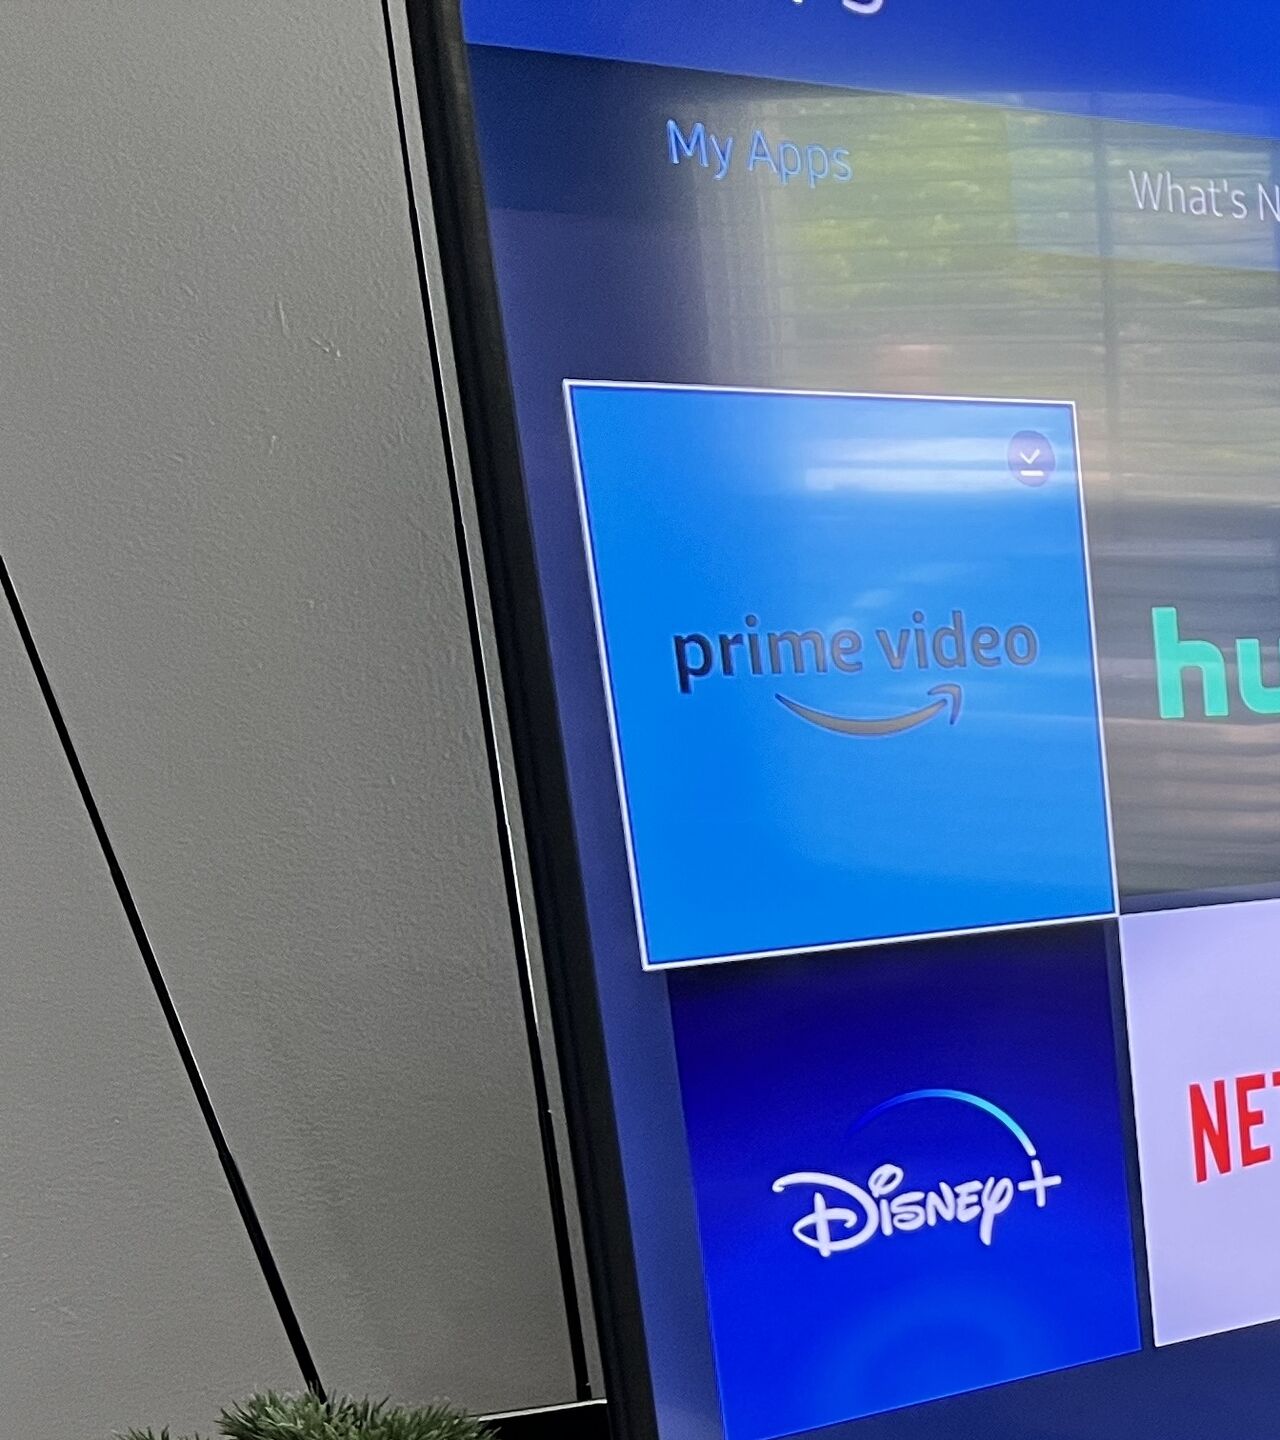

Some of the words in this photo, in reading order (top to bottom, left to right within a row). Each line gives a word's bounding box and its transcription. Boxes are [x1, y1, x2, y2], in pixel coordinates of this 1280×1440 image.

[666, 119, 733, 181] My
[748, 129, 854, 188] Apps
[1128, 169, 1248, 220] What's
[672, 613, 864, 696] prime
[873, 609, 1039, 671] video
